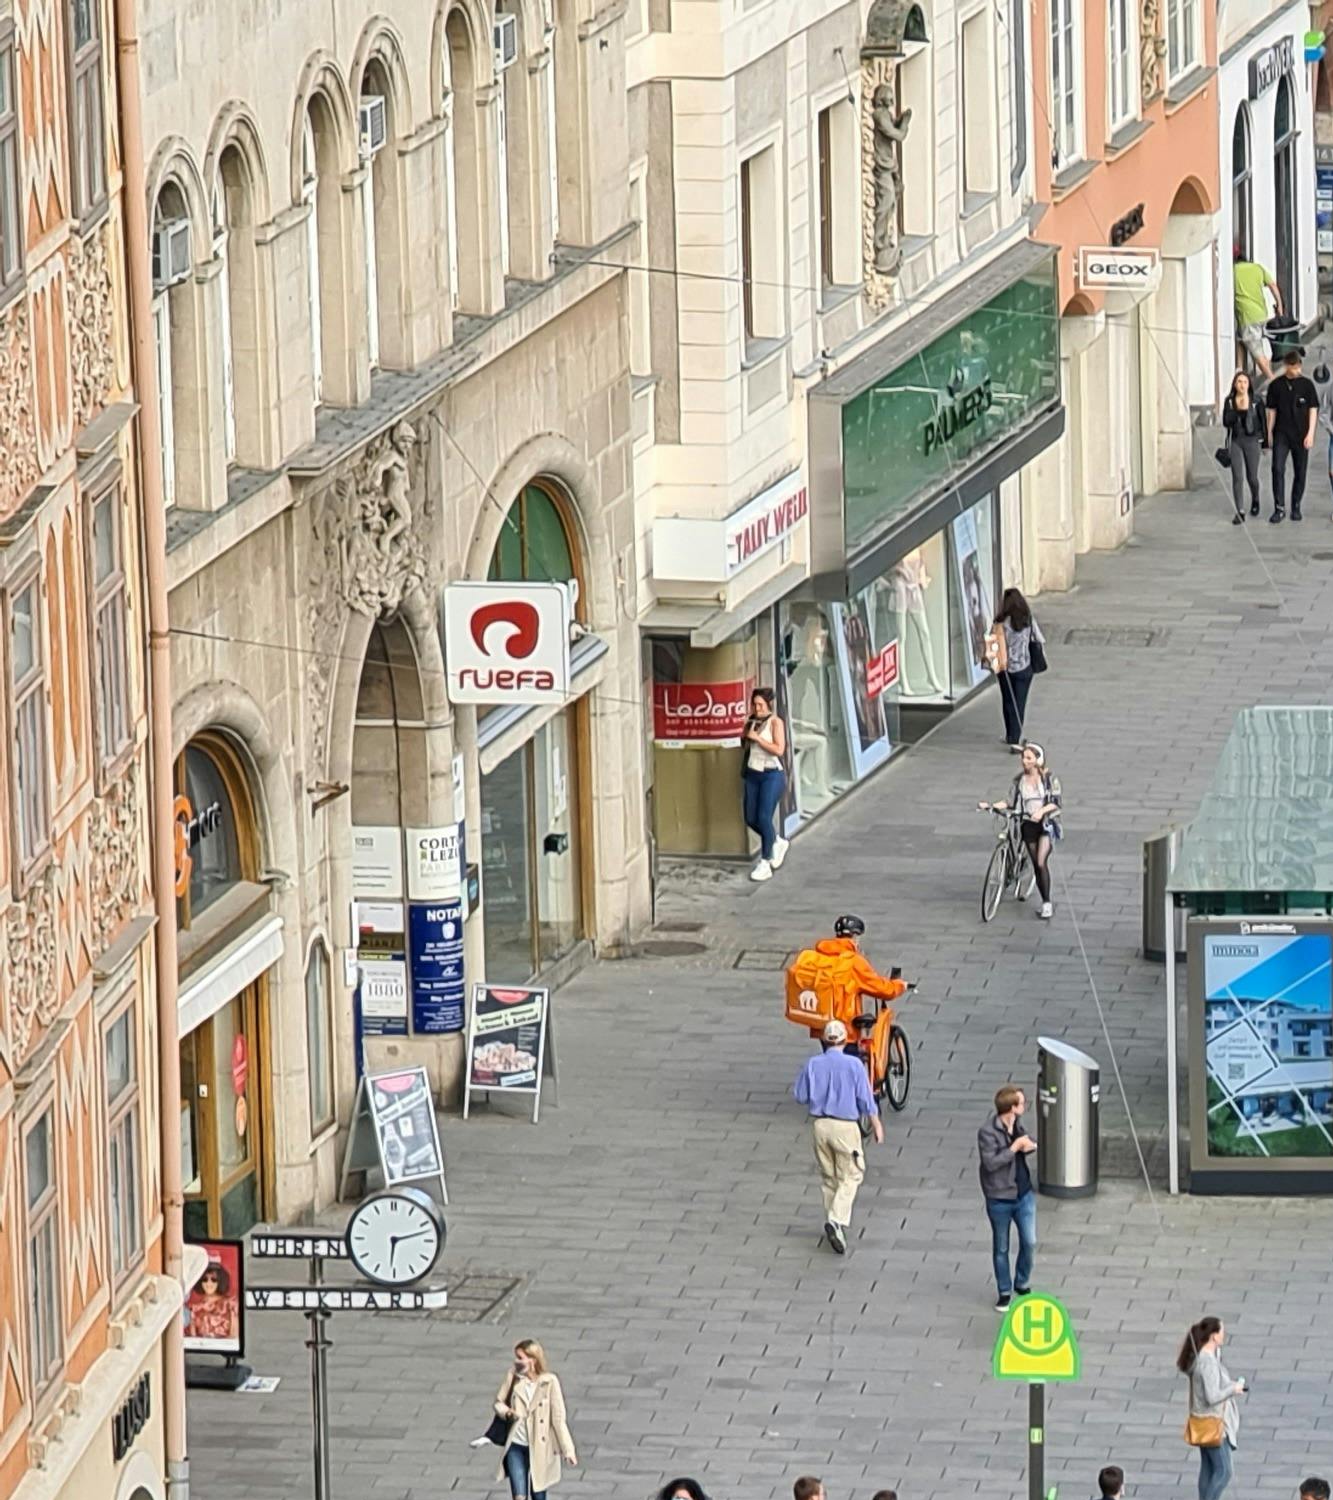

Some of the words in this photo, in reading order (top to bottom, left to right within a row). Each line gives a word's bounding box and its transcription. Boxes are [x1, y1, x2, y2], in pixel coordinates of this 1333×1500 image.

[1089, 263, 1148, 276] GEOX
[459, 669, 554, 690] ruefa
[257, 1239, 342, 1255] UHREN
[252, 1291, 424, 1308] WEIKHARD
[1023, 1306, 1052, 1343] H
